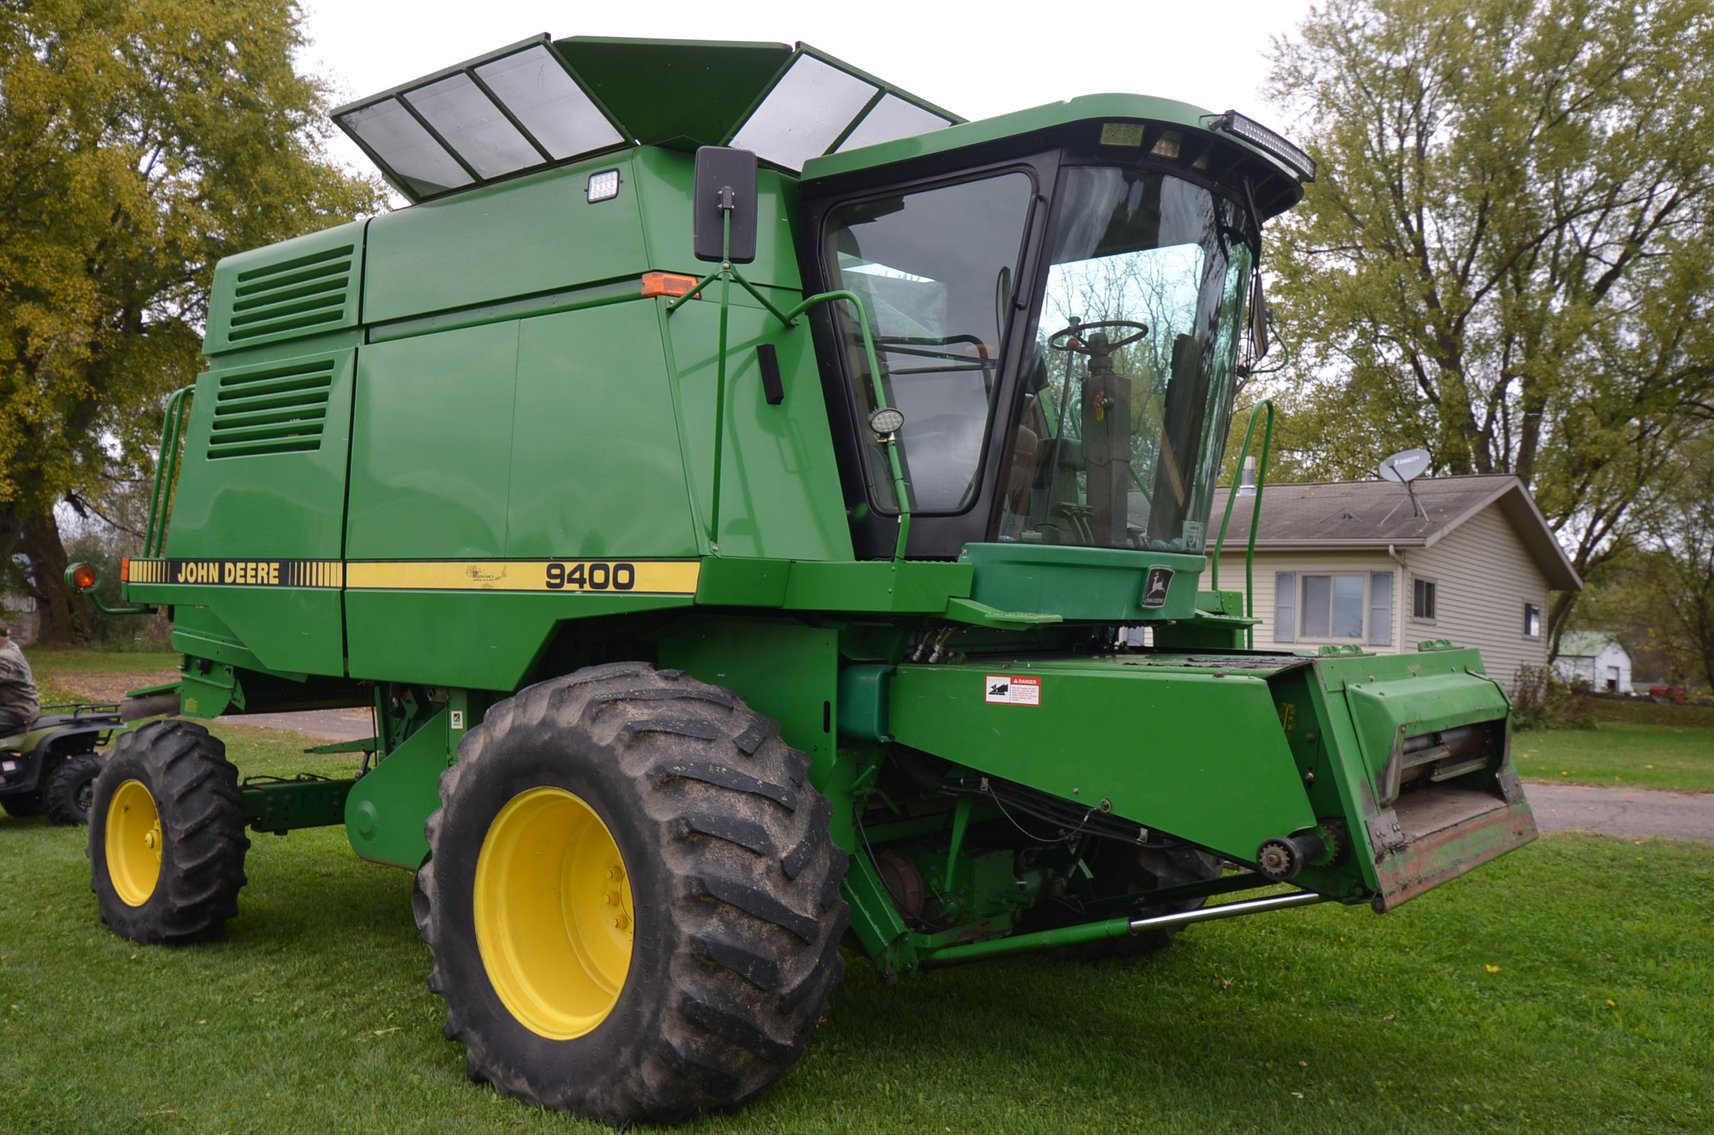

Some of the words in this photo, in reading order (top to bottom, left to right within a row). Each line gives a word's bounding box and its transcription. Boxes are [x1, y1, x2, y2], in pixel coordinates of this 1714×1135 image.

[177, 562, 219, 583] JOHN
[224, 562, 280, 584] DEERE
[545, 563, 635, 590] 9400
